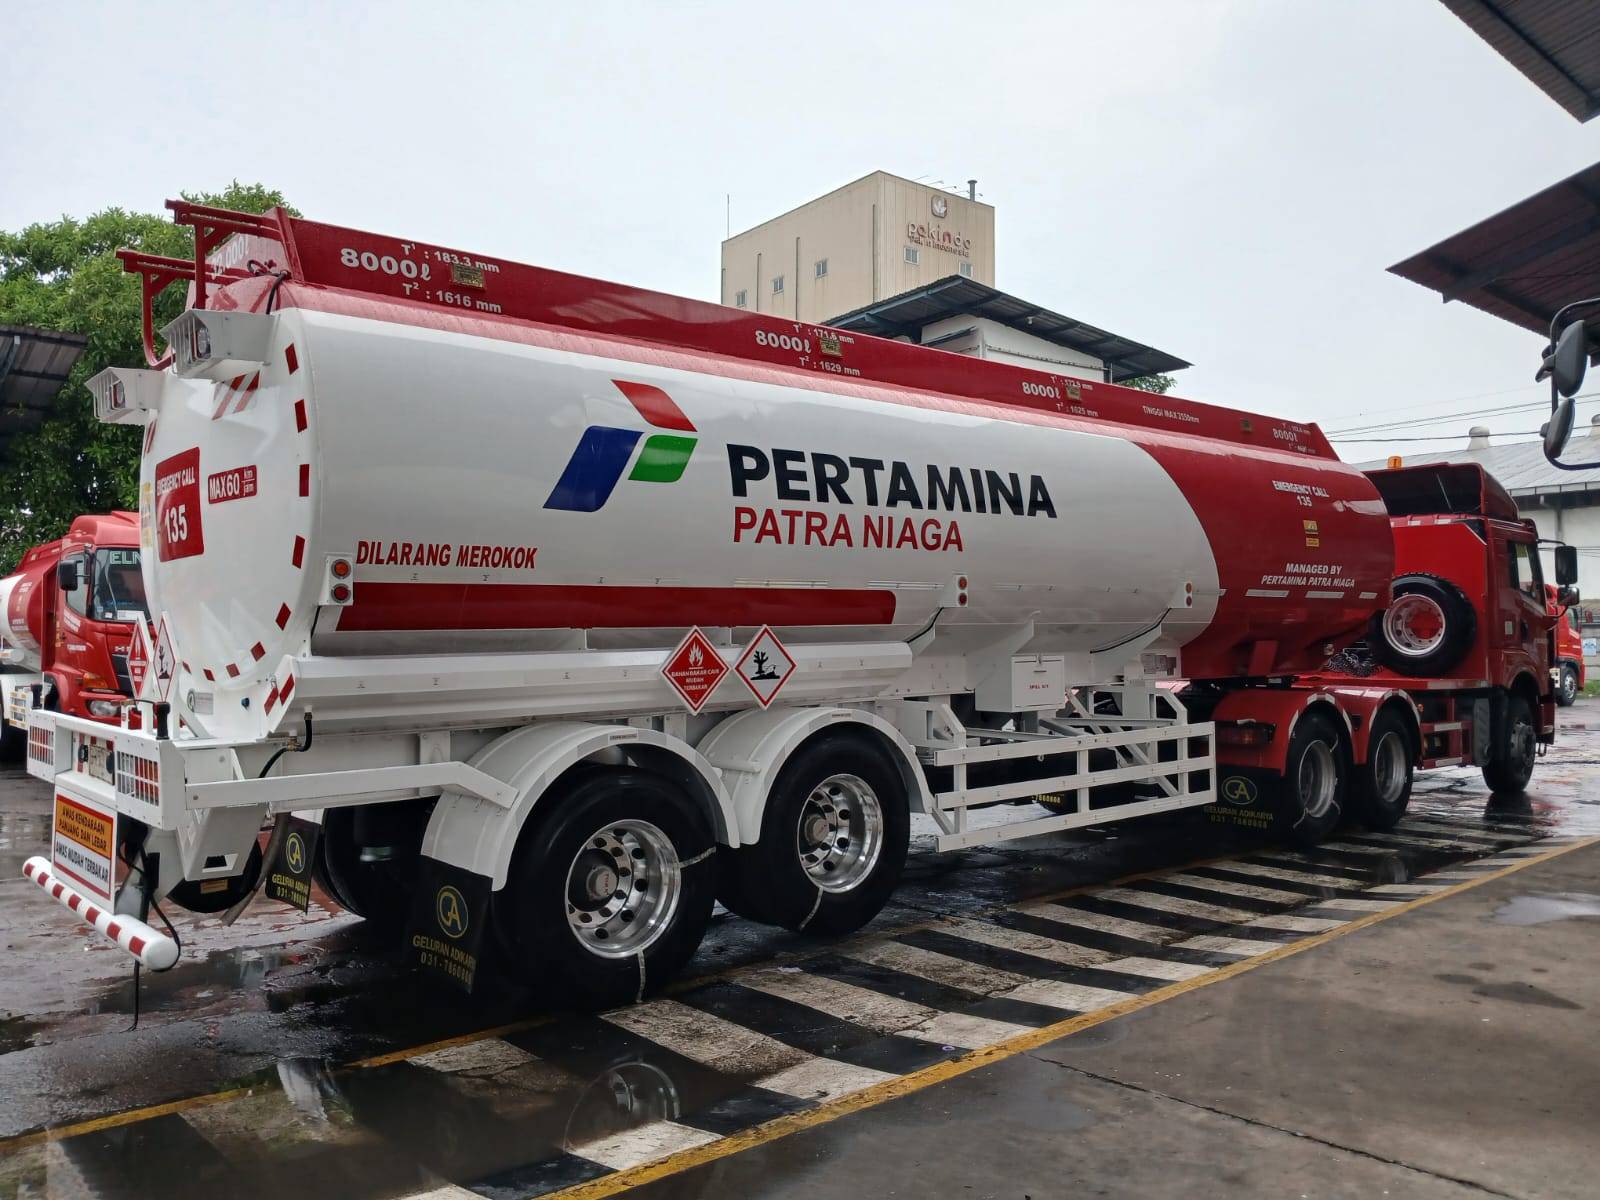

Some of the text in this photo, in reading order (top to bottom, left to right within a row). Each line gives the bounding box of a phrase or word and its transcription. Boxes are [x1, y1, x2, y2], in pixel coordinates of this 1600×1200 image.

[435, 251, 472, 267] 183.3
[476, 260, 500, 273] mm
[436, 290, 472, 307] 1616
[475, 300, 502, 313] mm
[819, 361, 842, 373] 1629
[844, 366, 861, 376] mm
[182, 466, 195, 486] CALL
[726, 443, 1057, 518] PERTAMINA
[1296, 495, 1312, 507] 135
[1312, 486, 1330, 498] CALL
[165, 504, 188, 543] 135
[733, 506, 964, 552] PATRA NIAGA
[356, 540, 538, 569] DILARANG MEROKOK
[1286, 563, 1342, 575] MANAGED BY
[1261, 575, 1355, 588] PERTAMINA PATRA NIAGA
